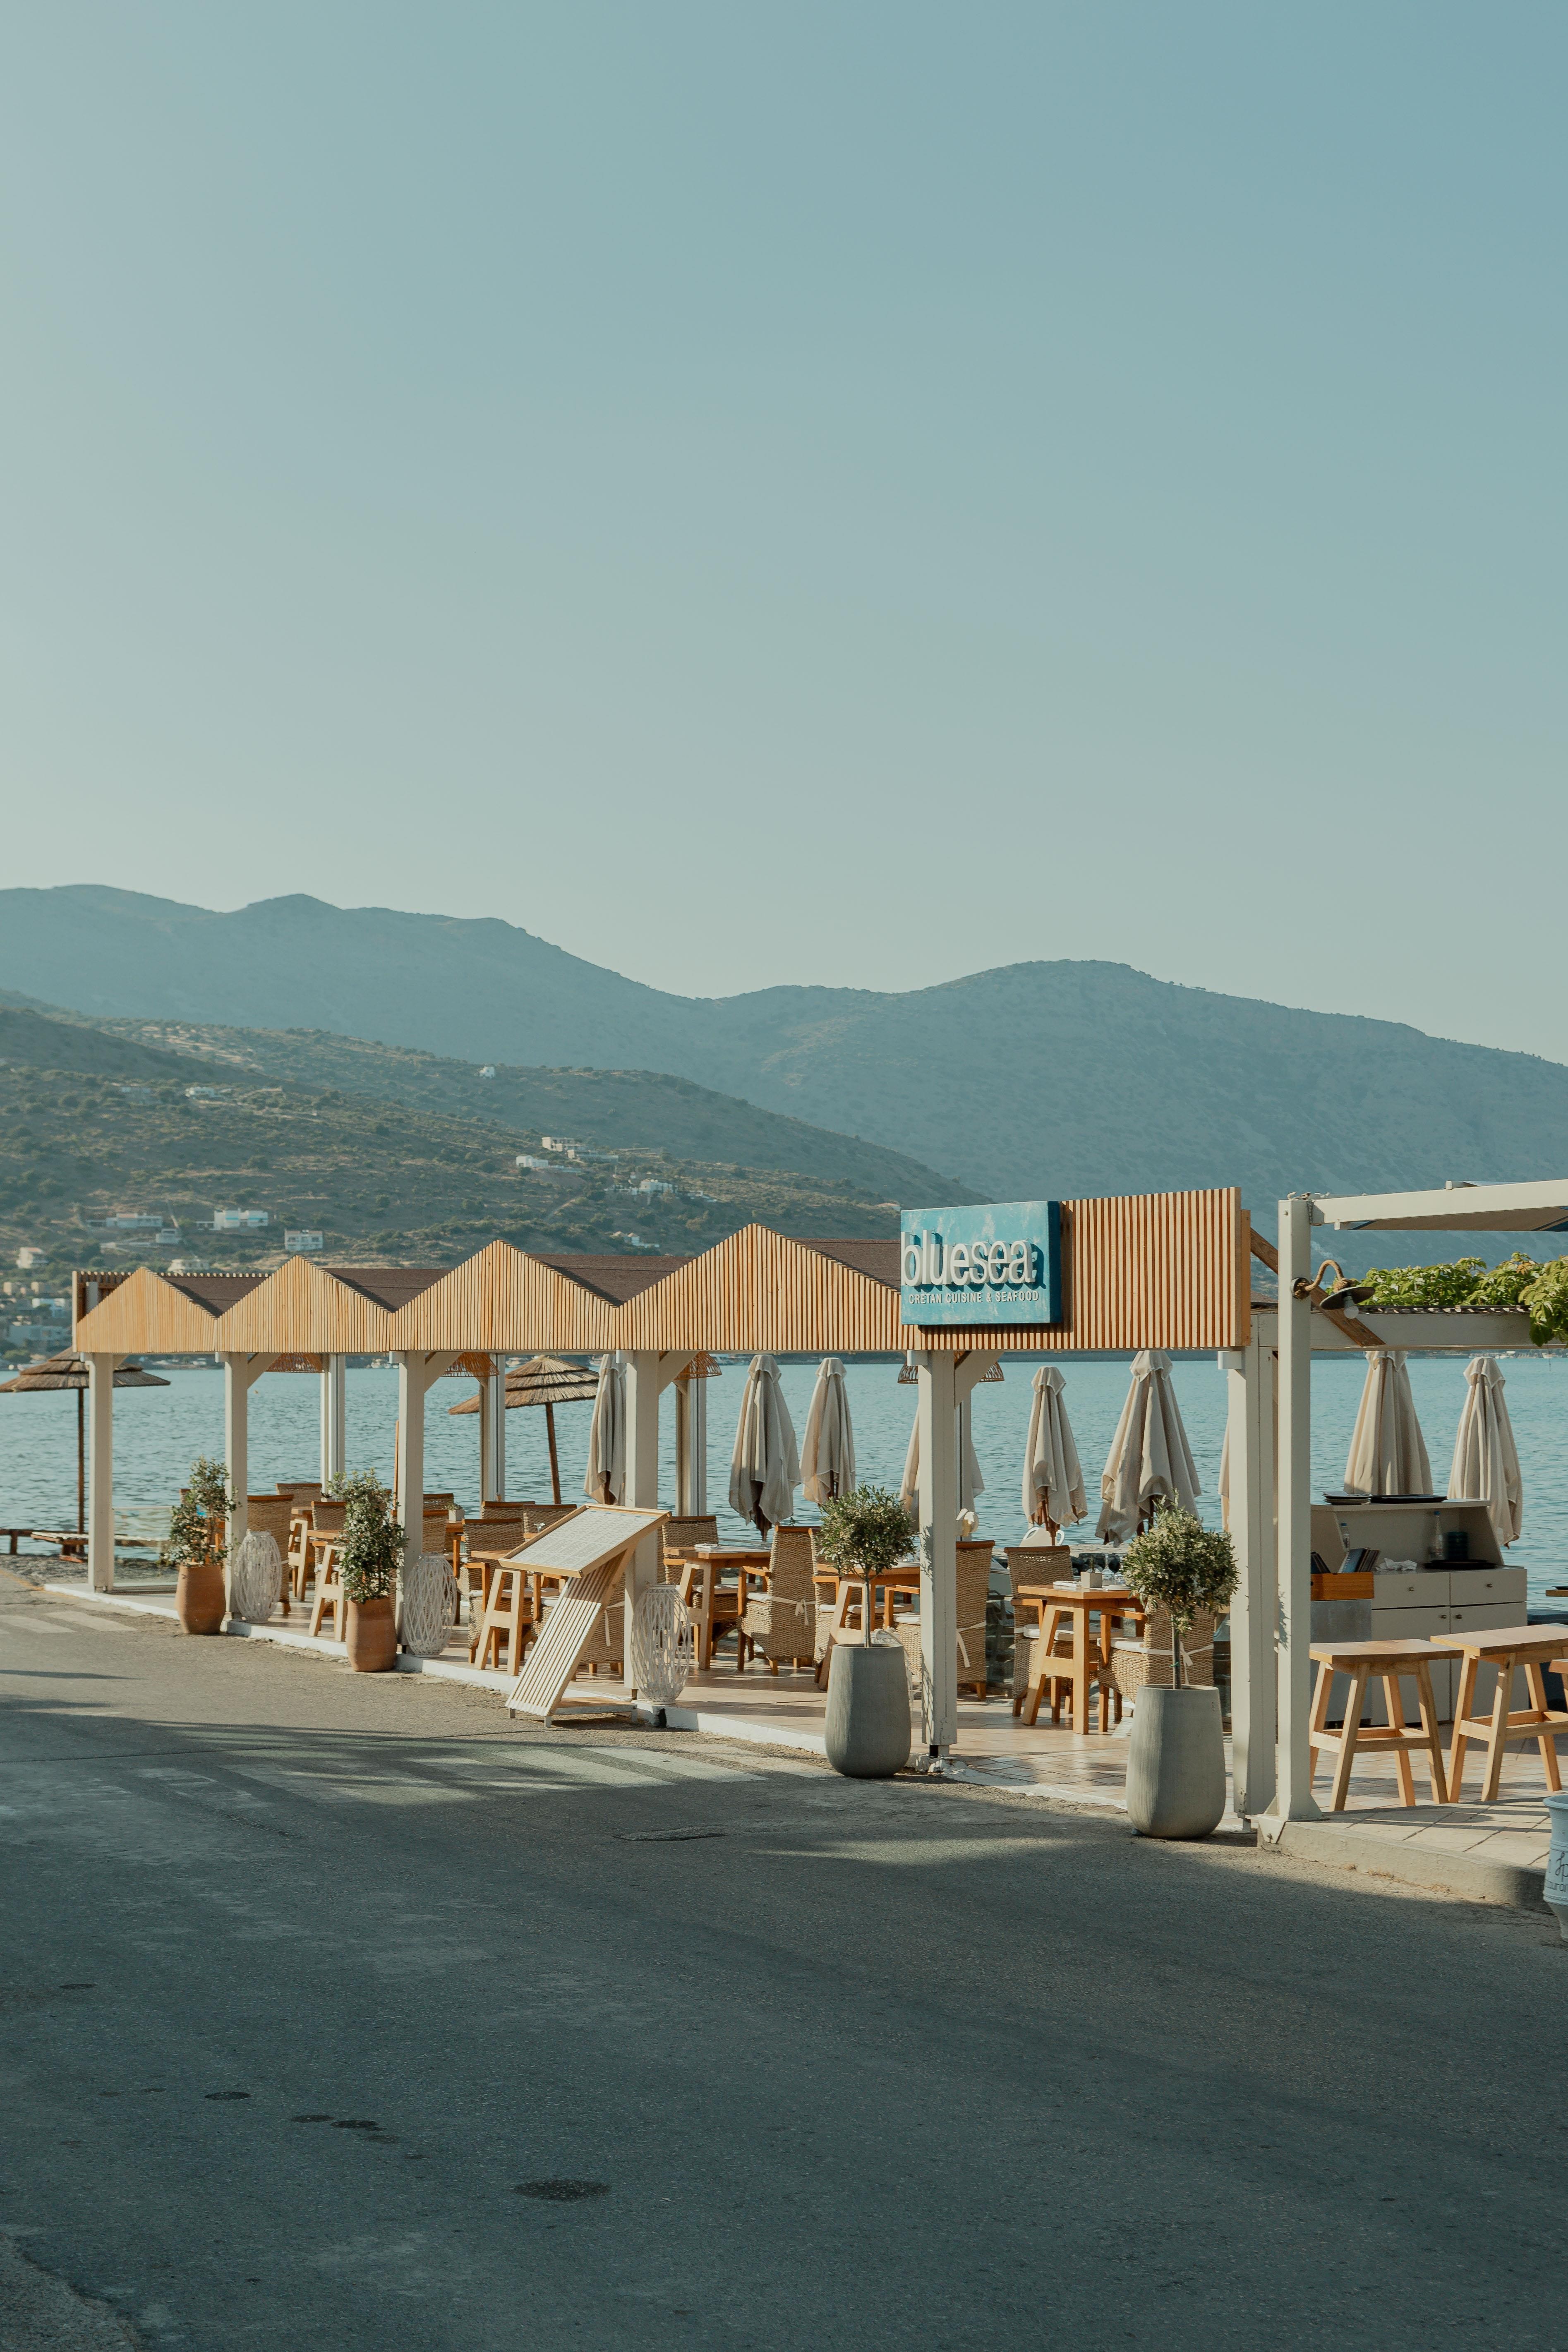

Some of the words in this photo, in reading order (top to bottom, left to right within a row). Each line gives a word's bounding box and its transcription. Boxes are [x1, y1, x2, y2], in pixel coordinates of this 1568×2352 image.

[901, 1230, 1035, 1286] bluesea
[909, 1293, 942, 1304] CRETAN
[946, 1292, 983, 1303] CUISINE
[986, 1292, 992, 1302] &
[995, 1290, 1039, 1302] SEAFOOD
